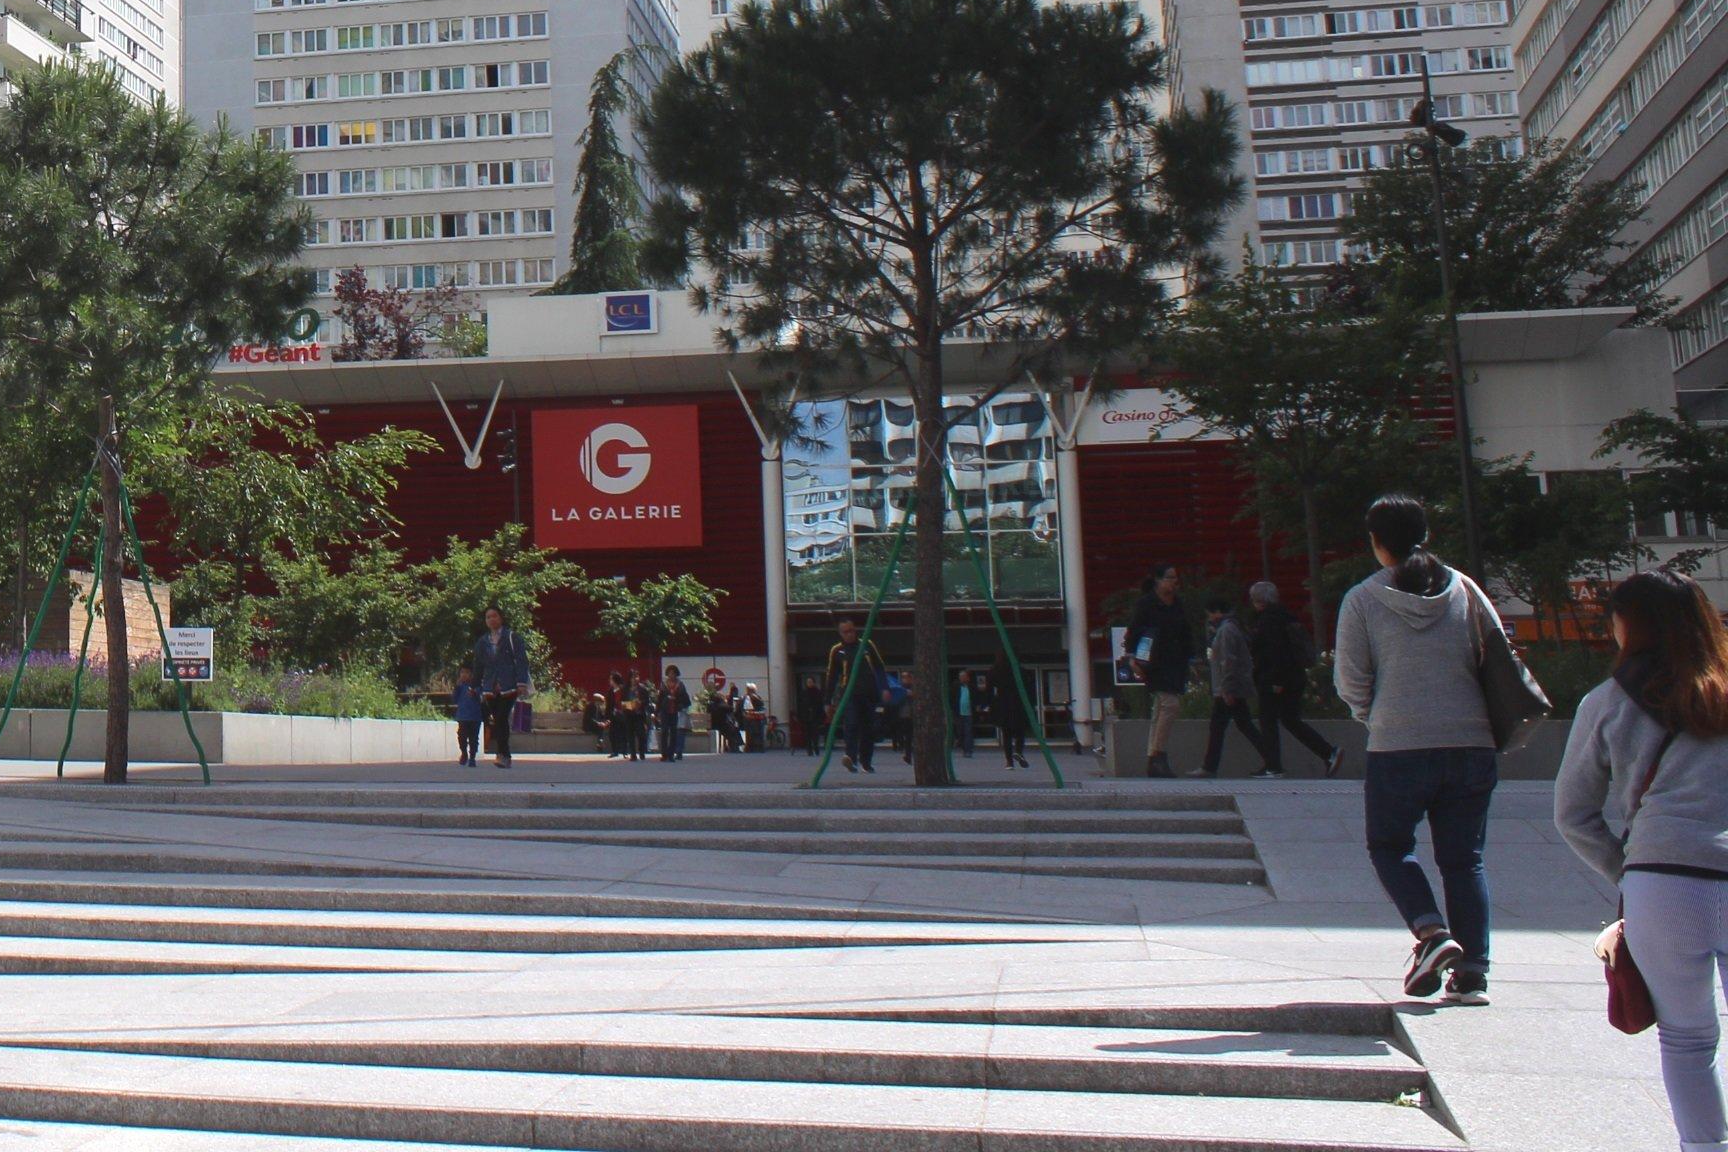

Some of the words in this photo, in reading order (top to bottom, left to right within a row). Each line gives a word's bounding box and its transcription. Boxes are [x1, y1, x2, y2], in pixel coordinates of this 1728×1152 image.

[609, 304, 648, 316] LCL
[1102, 409, 1155, 425] Casino
[579, 422, 651, 495] G
[551, 508, 580, 522] LA
[589, 505, 682, 521] GALERIE
